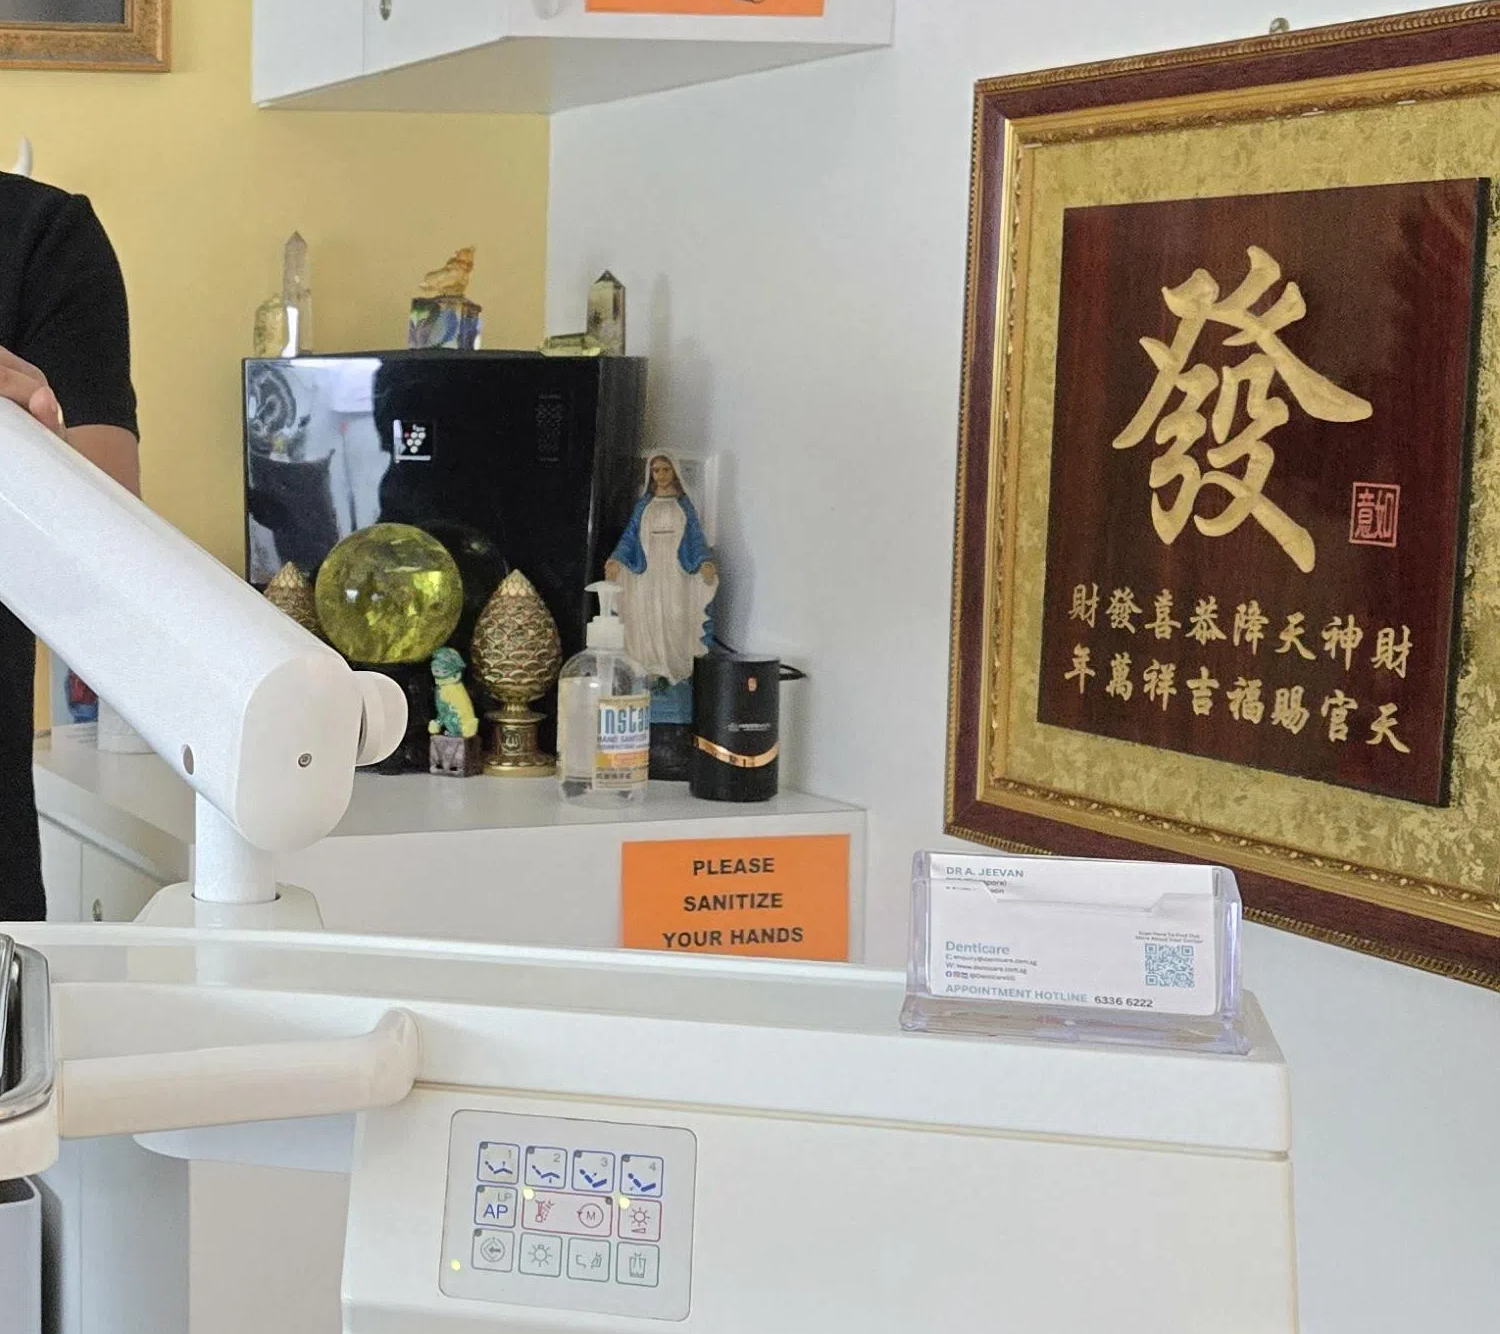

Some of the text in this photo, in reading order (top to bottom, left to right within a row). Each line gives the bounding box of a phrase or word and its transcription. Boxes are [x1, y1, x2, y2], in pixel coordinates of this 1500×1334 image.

[1112, 245, 1373, 573] 發
[692, 857, 775, 876] PLEASE
[946, 866, 962, 876] DR
[979, 868, 1024, 878] JEEVAN
[683, 892, 783, 912] SANITIZE
[662, 927, 804, 948] YOUR HANDS
[945, 940, 1010, 956] Denticare
[945, 984, 1154, 1009] APPOINTMENT HOTLINE 6336 6222
[483, 1203, 508, 1220] AP
